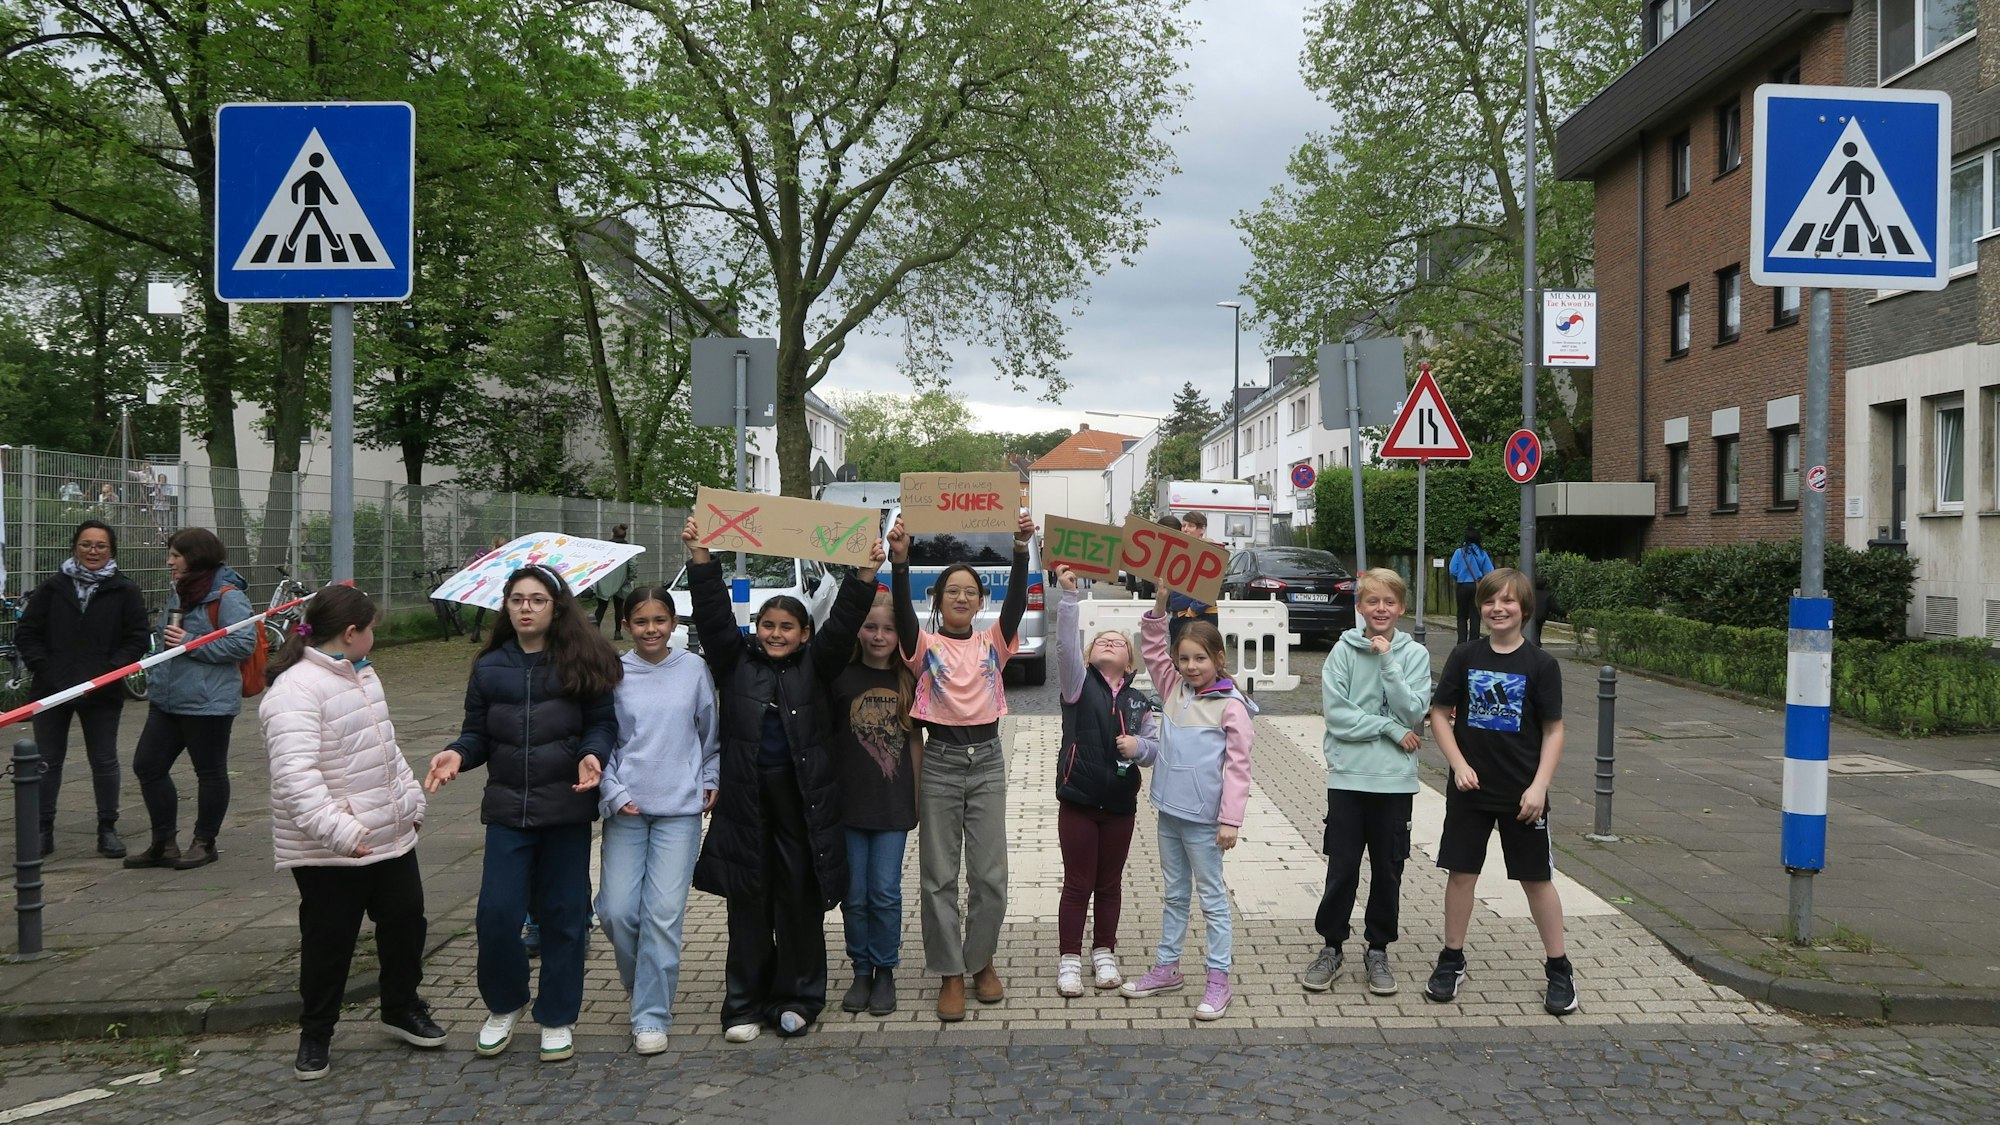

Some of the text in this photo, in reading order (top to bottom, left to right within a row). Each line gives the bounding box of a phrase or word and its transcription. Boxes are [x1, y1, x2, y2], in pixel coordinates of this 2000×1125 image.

[904, 477, 926, 491] Der
[936, 492, 1004, 512] SICHER
[1051, 527, 1122, 567] JETZT
[1122, 529, 1222, 593] STOP
[979, 573, 1010, 587] OLIZ
